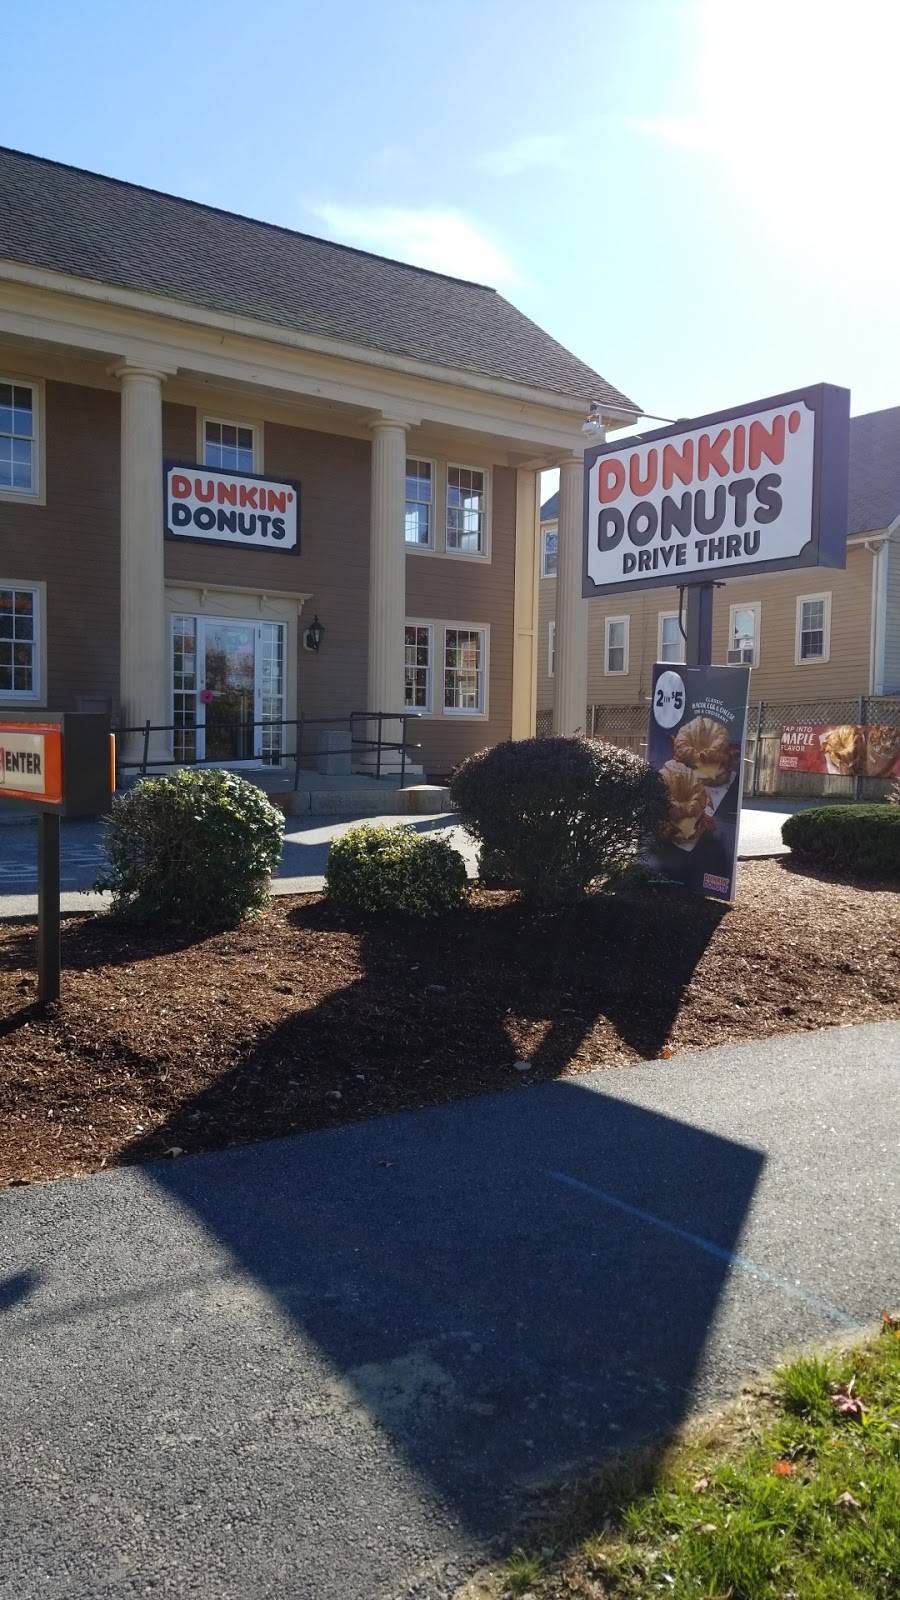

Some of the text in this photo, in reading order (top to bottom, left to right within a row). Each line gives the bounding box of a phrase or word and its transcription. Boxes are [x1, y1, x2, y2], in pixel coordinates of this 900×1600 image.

[598, 410, 800, 504] DUNKIN'
[171, 474, 293, 513] DUNKIN'
[597, 473, 783, 552] DONUTS
[171, 502, 286, 540] DONUTS
[622, 530, 761, 575] DRIVE THRU
[656, 690, 664, 707] 2
[671, 691, 683, 710] $5
[781, 732, 817, 746] MAPLE
[5, 751, 42, 775] ENTER
